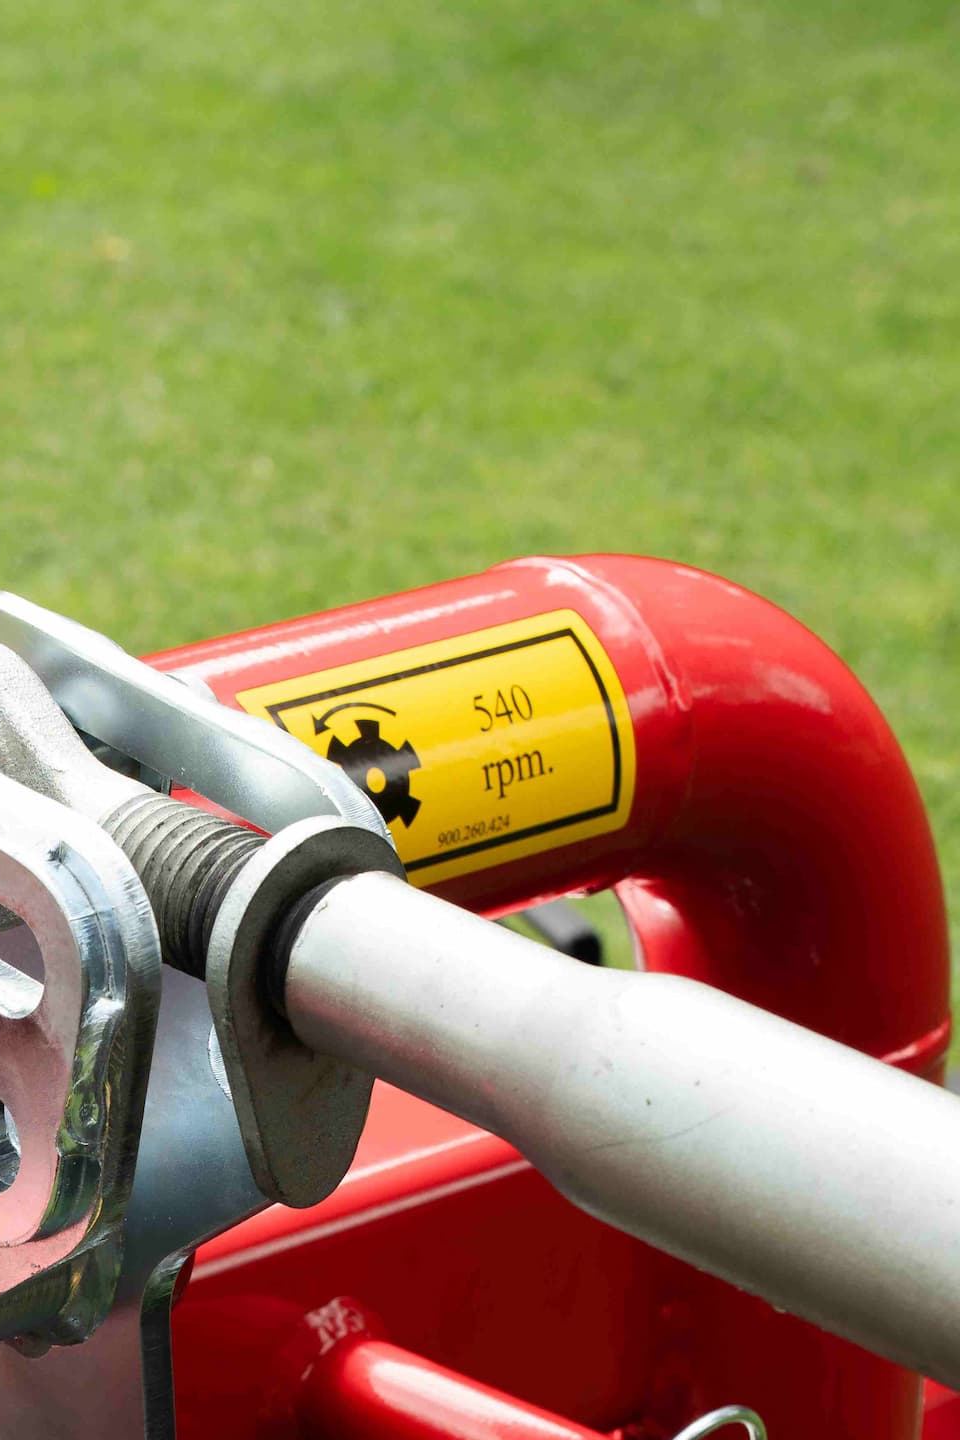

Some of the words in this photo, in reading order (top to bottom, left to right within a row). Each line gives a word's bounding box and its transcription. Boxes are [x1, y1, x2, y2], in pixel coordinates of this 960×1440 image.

[473, 685, 532, 732] 540
[483, 749, 554, 799] rpm.
[437, 814, 511, 848] 900.260.424
